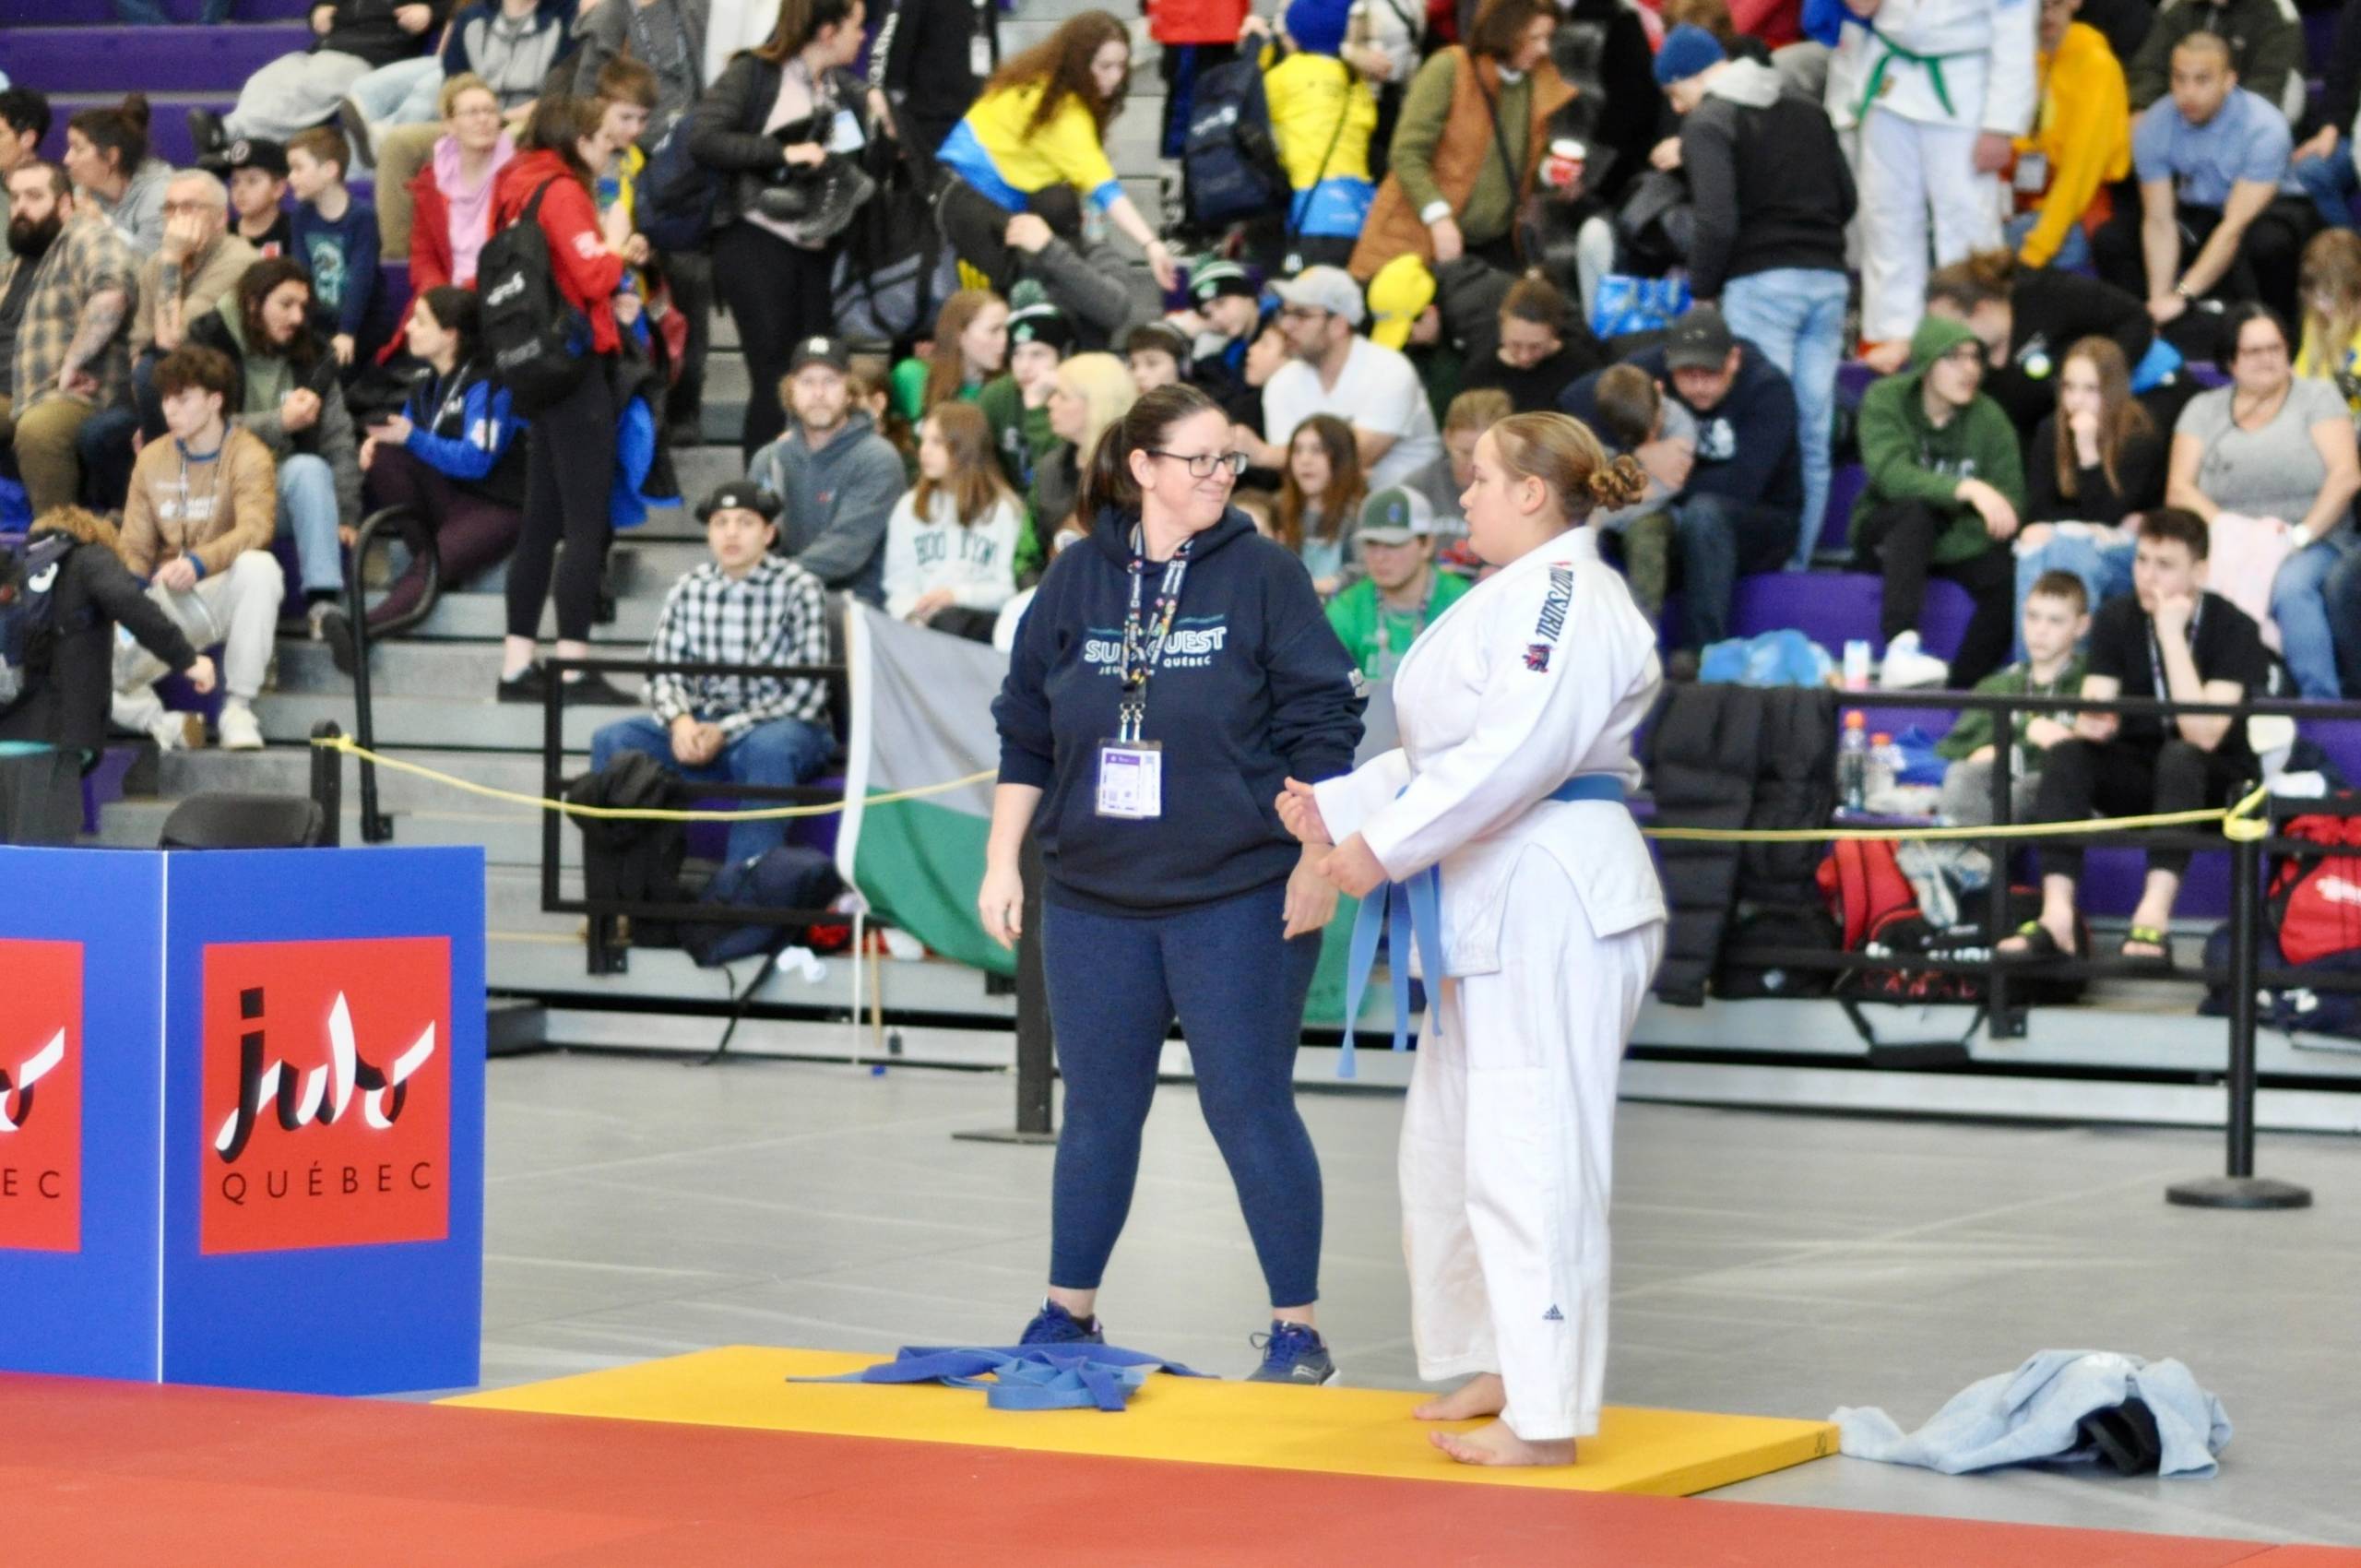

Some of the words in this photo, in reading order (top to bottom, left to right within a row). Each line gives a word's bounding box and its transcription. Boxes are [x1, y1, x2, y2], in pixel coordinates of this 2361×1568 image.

[1084, 639, 1136, 663] SU
[214, 985, 435, 1164] judo
[221, 1160, 432, 1206] QUÉBEC
